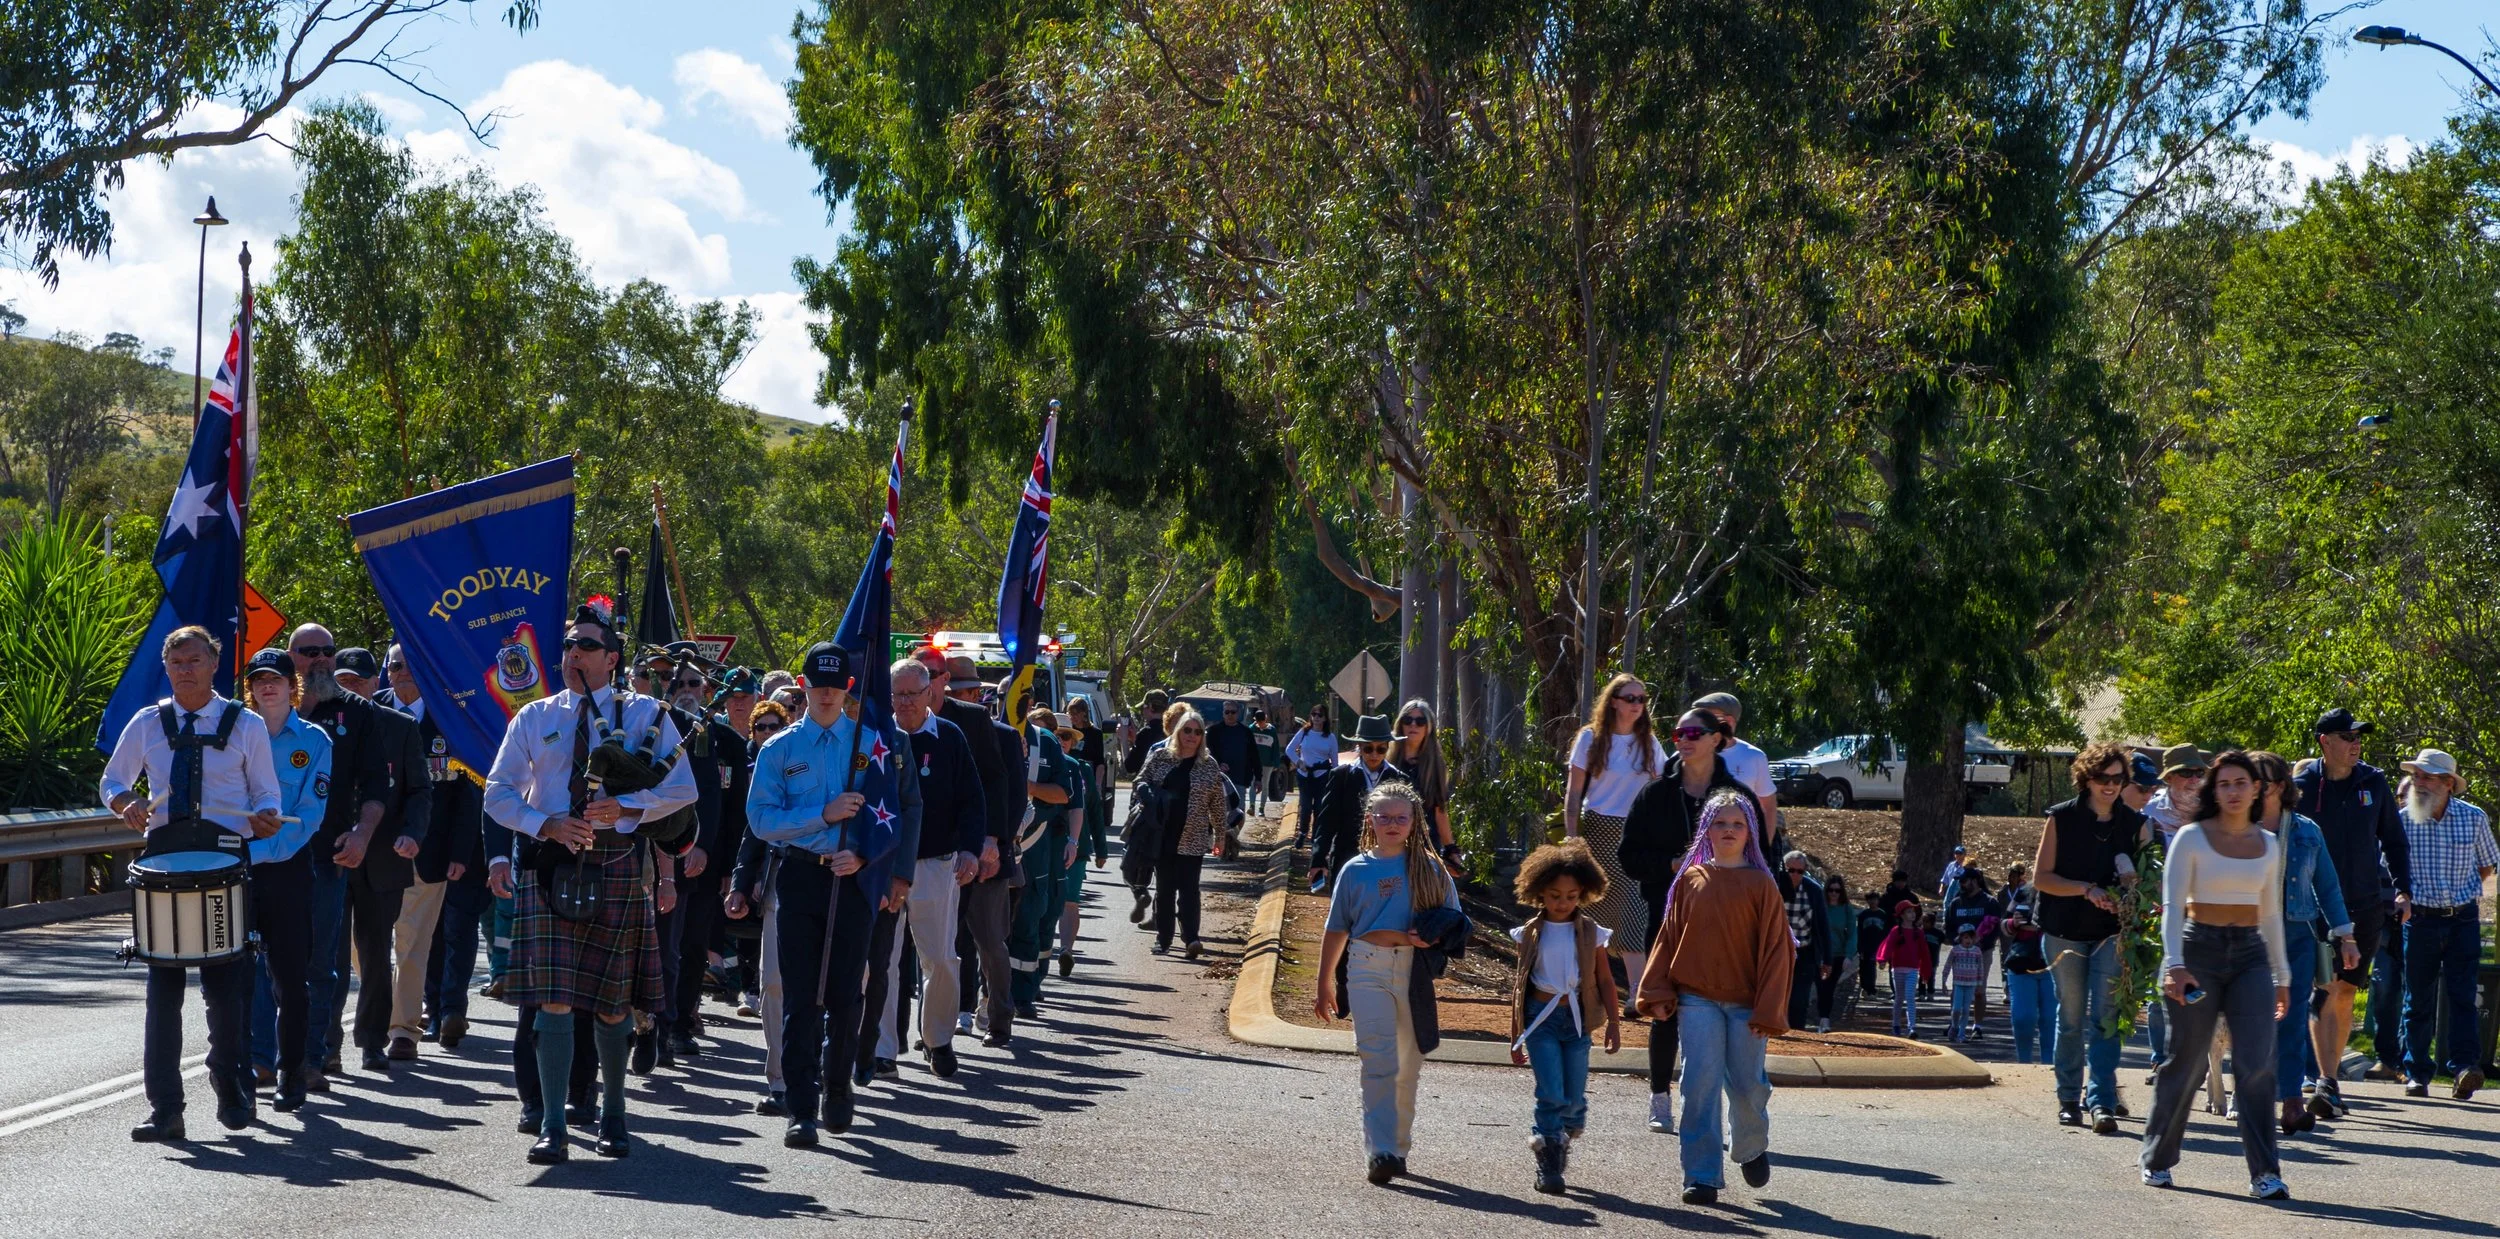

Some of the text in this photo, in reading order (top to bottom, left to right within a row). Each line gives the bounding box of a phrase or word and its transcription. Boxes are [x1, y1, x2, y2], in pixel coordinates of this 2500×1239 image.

[428, 566, 551, 622] TOODYAY
[467, 606, 527, 630] SUB BRANCH
[698, 644, 721, 652] GIVE
[818, 658, 840, 666] DFES
